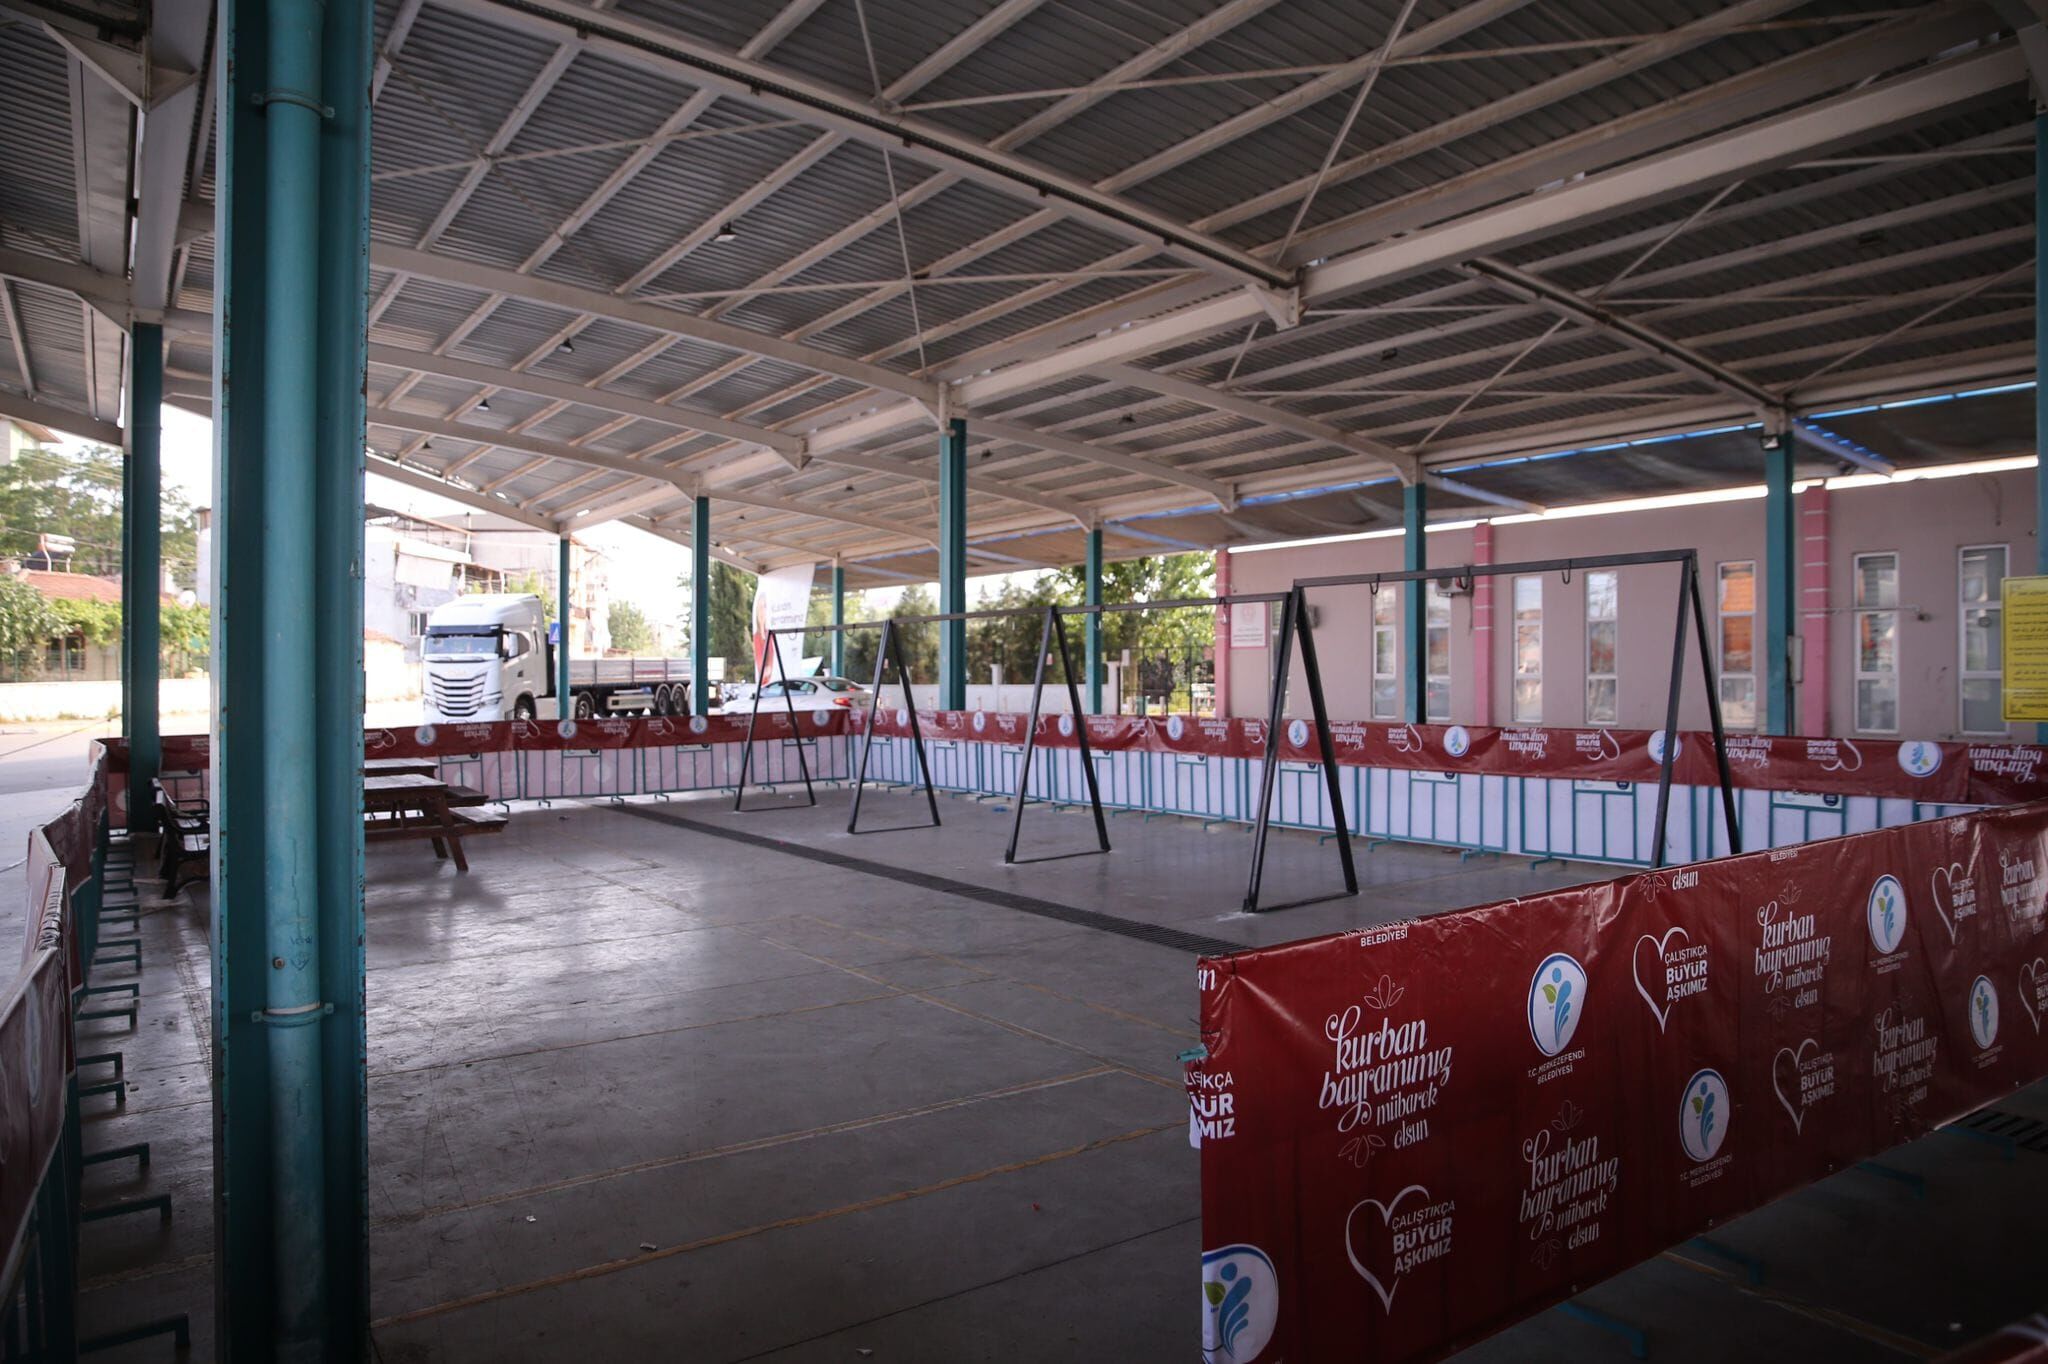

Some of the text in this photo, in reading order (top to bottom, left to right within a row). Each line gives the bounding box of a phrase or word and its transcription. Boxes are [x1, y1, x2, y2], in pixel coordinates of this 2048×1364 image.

[1974, 759, 2037, 785] kurban
[1672, 868, 1699, 890] olsun
[1757, 901, 1815, 949] kurban
[1664, 945, 1708, 967] ÇALIŞTIKÇA
[1666, 960, 1708, 985] BÜYÜR
[1666, 978, 1707, 1002] AŞKIMIZ
[1325, 1005, 1428, 1075] kurban
[1801, 1066, 1834, 1091] BÜYÜR
[1376, 1081, 1438, 1127] mübarek
[1393, 1118, 1429, 1150] olsun
[1523, 1129, 1599, 1191] kurban
[1391, 1200, 1455, 1232] ÇALIŞTIKÇA
[1556, 1189, 1607, 1231] mübarek
[1393, 1217, 1452, 1254] BÜYÜR
[1568, 1222, 1600, 1250] olsun
[1394, 1237, 1451, 1275] AŞKIMIZ
